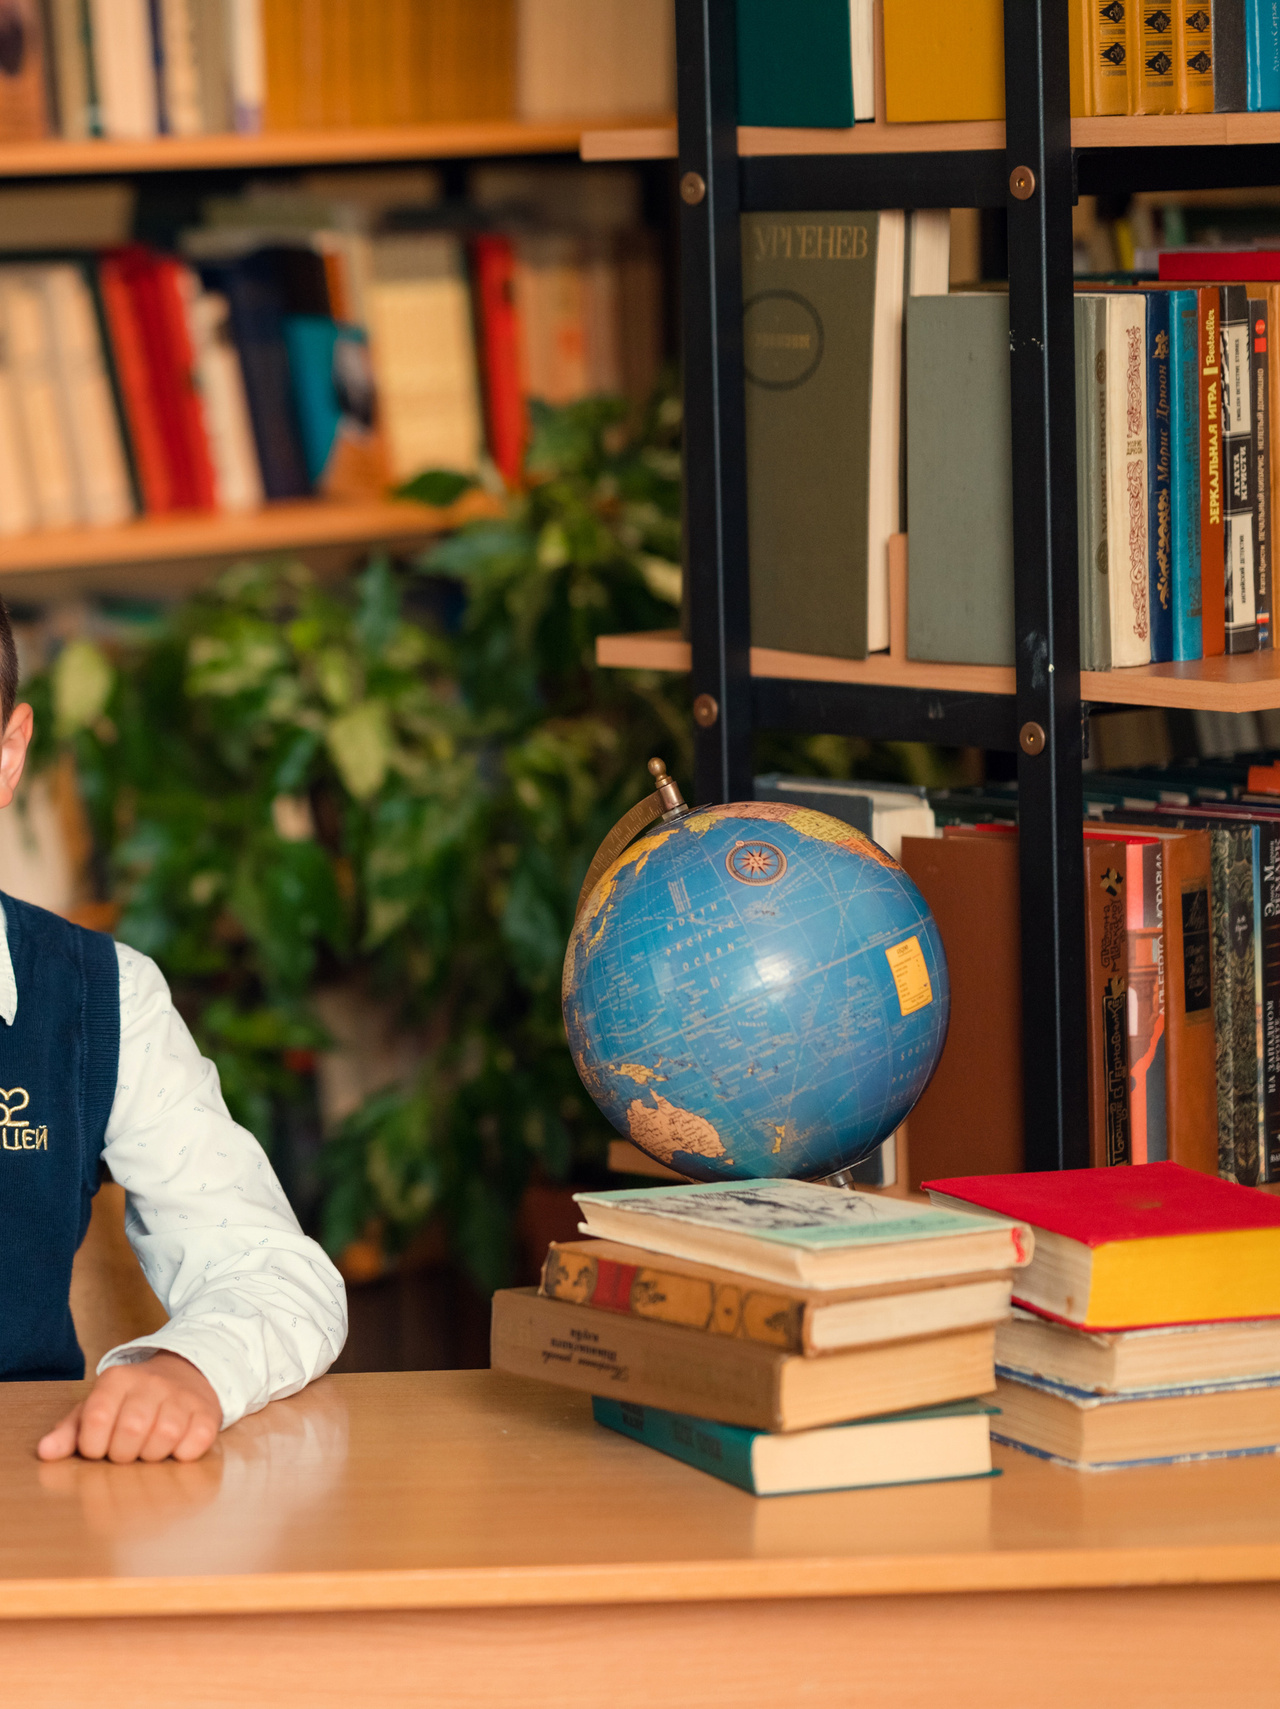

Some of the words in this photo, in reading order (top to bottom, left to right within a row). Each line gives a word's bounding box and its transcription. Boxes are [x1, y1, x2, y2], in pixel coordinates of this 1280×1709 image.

[754, 224, 868, 261] УРГЕНЕВ
[1205, 308, 1216, 367] Bestseller
[1156, 364, 1170, 424] Дрюон
[1207, 381, 1218, 420] ИГРА
[1256, 368, 1265, 412] ДОМИШКО
[1157, 428, 1170, 483] Морис
[1208, 423, 1220, 525] ЗЕРКАЛЬНАЯ
[1233, 452, 1241, 497] АГАТА
[1239, 445, 1248, 501] КРИСТИ
[1257, 494, 1266, 541] ПЕЧАЛЬНЫЙ
[666, 903, 718, 932] NORTH
[666, 920, 735, 957] PACIFIC
[682, 942, 735, 972] OCEAN
